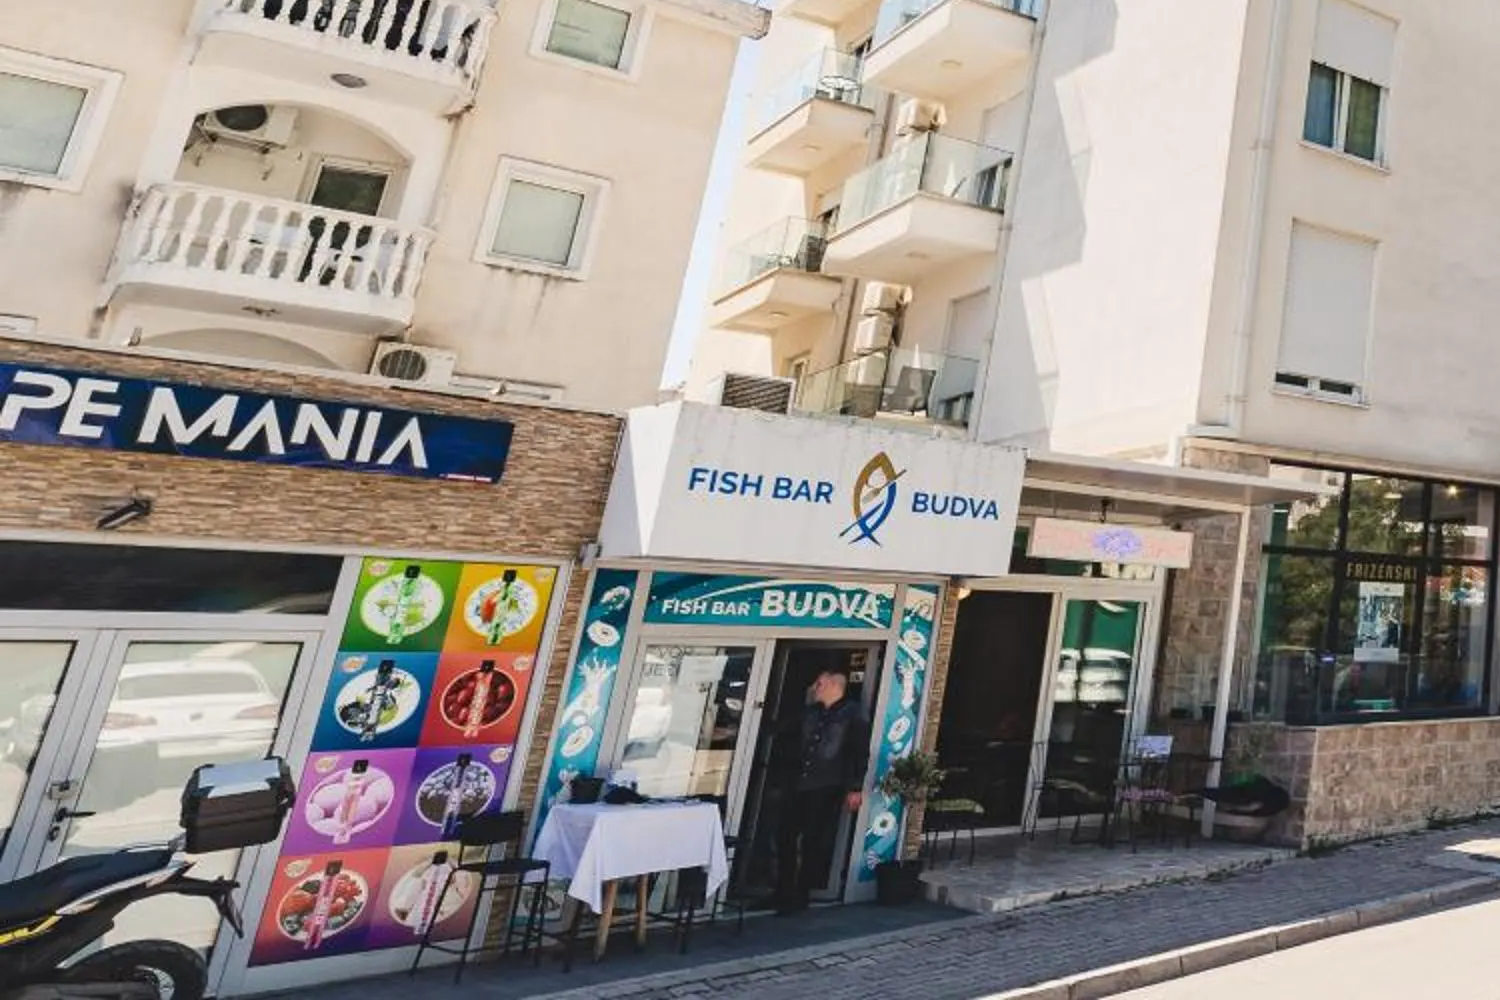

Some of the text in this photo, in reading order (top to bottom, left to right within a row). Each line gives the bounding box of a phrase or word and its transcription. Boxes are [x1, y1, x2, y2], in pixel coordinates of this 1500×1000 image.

[138, 387, 429, 469] MANIA
[688, 468, 999, 520] FISH BAR BUDVA
[661, 590, 880, 619] FISH BAR BUDVA
